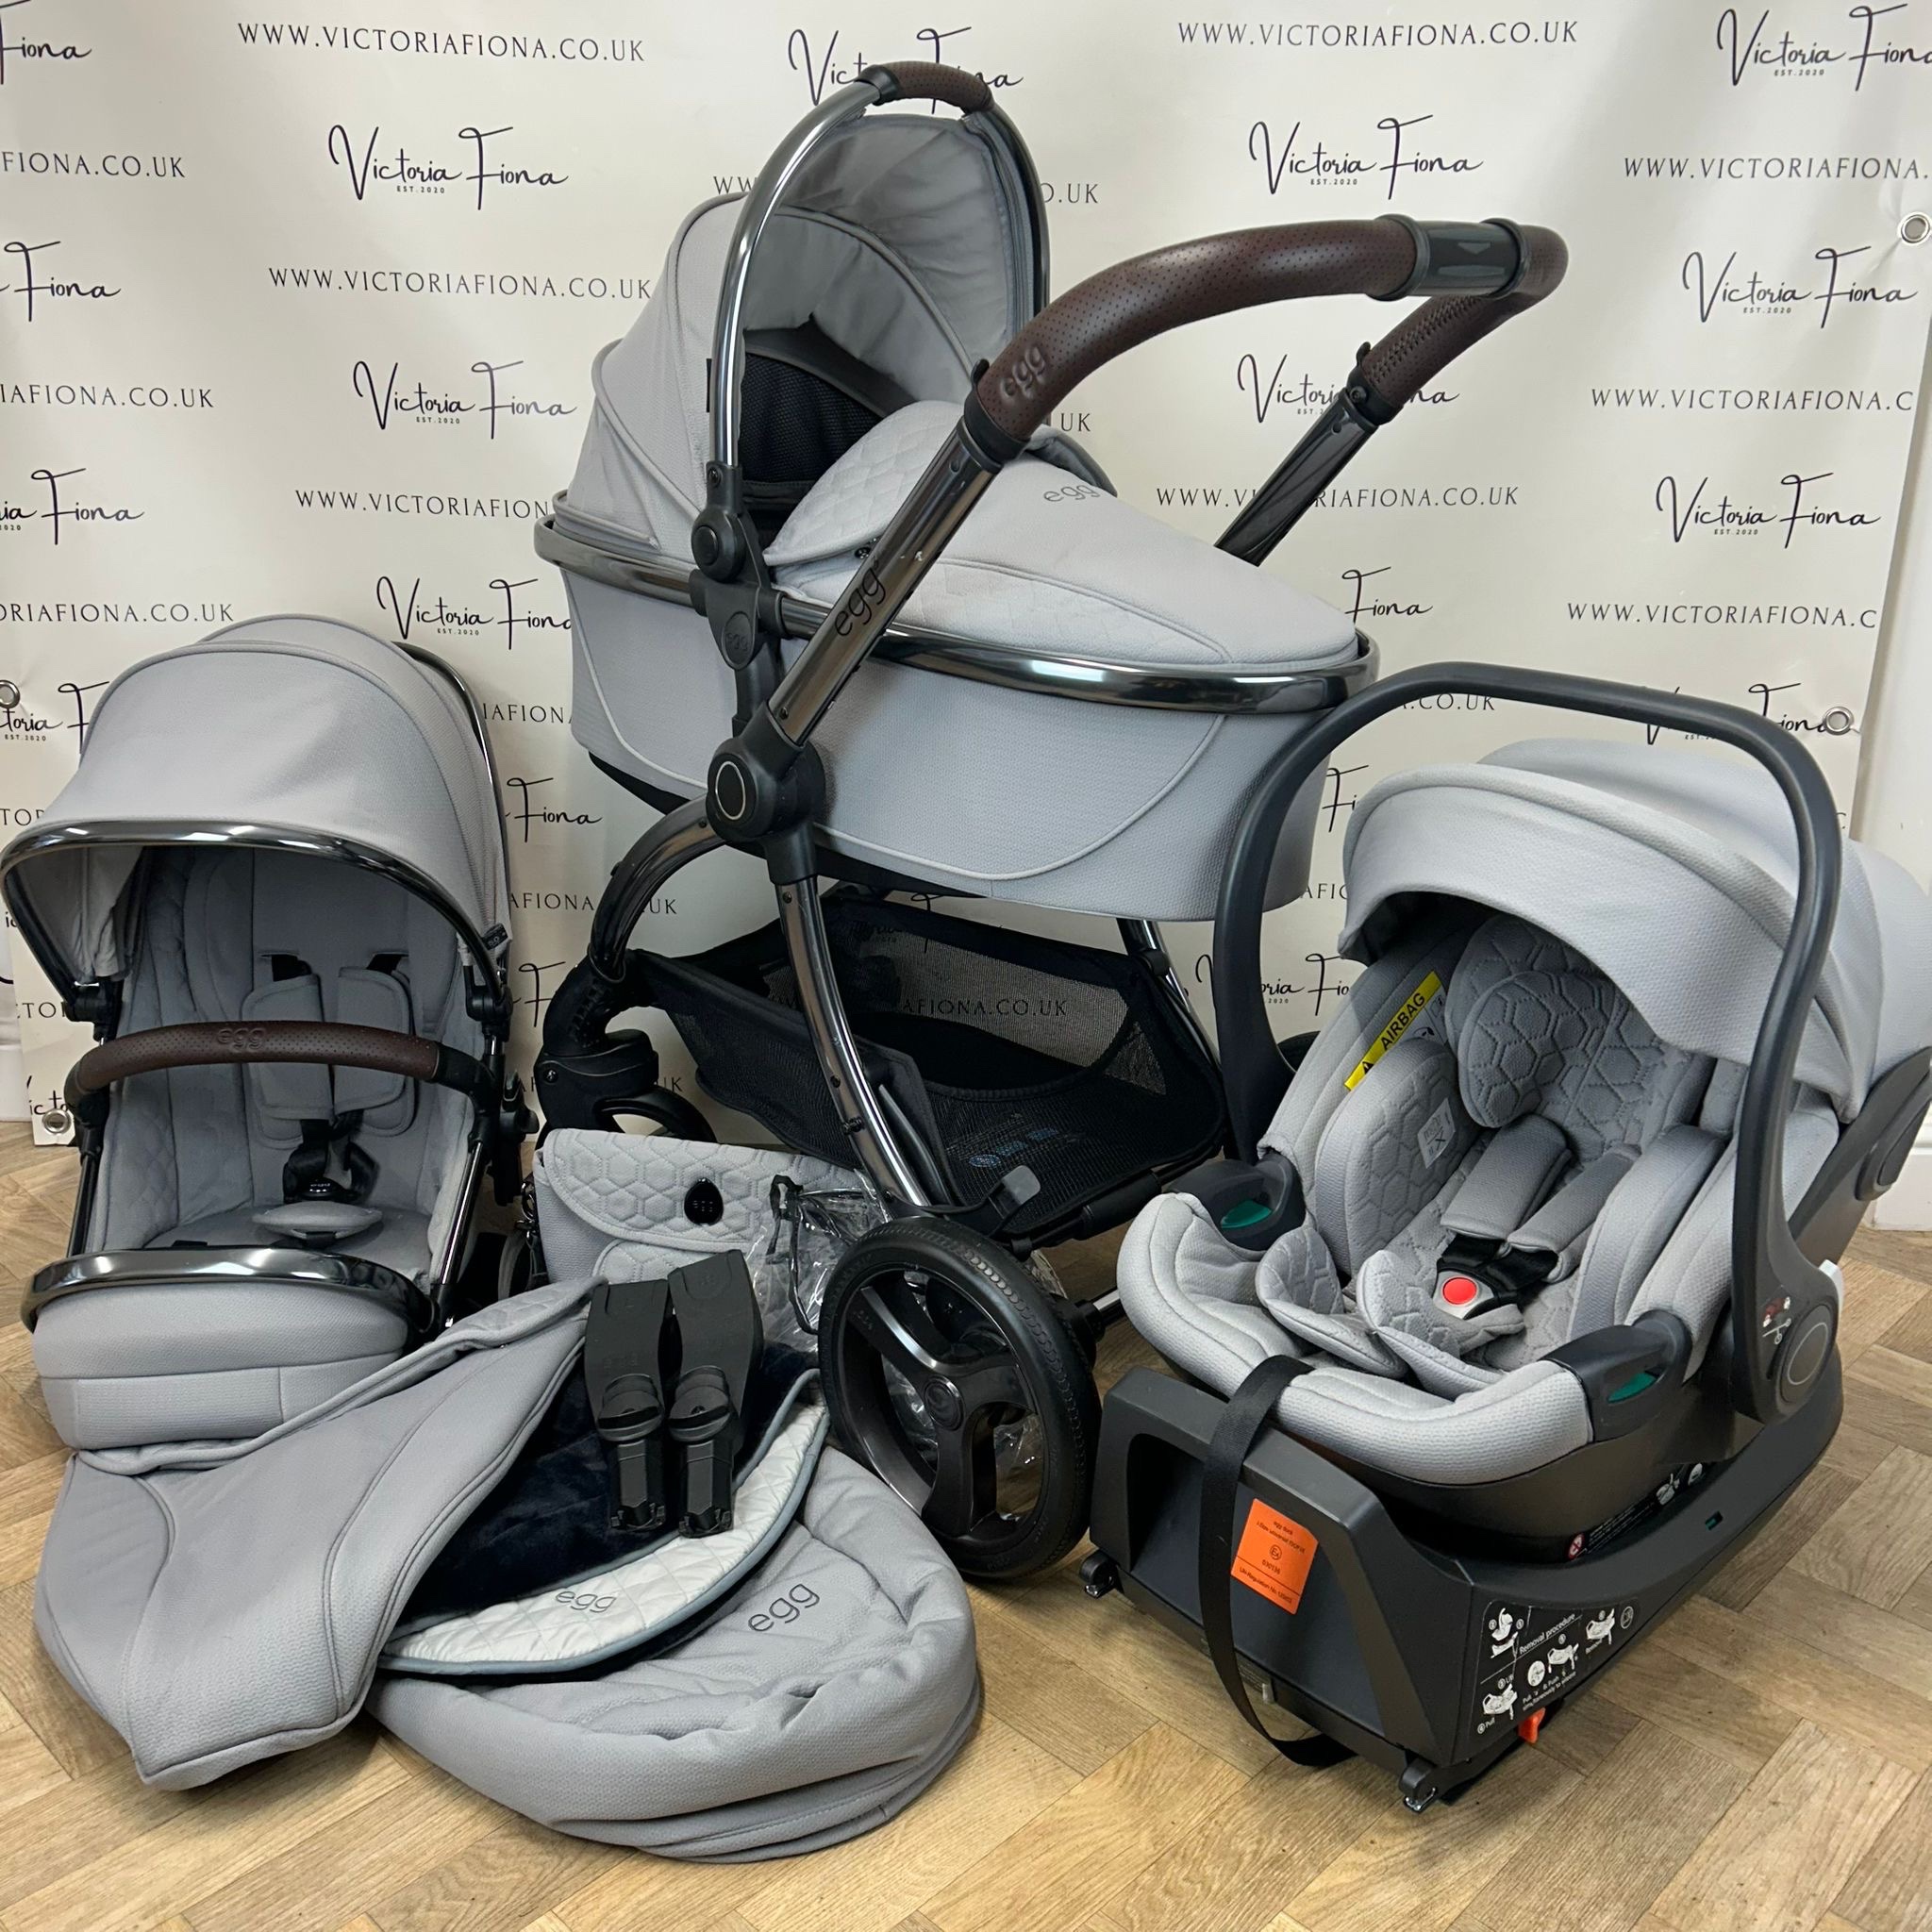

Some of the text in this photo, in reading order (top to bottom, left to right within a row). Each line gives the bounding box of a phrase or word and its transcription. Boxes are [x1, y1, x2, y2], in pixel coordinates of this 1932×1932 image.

[238, 23, 644, 62] WWW.VICTORIAFIONA.CO.UK
[1178, 21, 1578, 46] WWW.VICTORIAFIONA.CO.UK
[1717, 8, 1846, 86] Victoria
[328, 125, 569, 210] Victoria Fiona
[1249, 114, 1484, 200] Victoria Fiona
[1624, 157, 1930, 179] WWW.VICTORIAFIONA.
[396, 185, 445, 194] EST.2020
[4, 241, 121, 322] Fiona
[269, 267, 652, 300] WWW.VICTORIAFIONA.CO.UK
[1682, 245, 1919, 328] Victoria Fiona
[353, 360, 577, 440] Victoria Fiona
[1000, 344, 1046, 404] egg
[1591, 389, 1914, 411] WWW.VICTORIAFIONA.C
[416, 416, 460, 425] EST.2020
[31, 468, 145, 545] Fiona
[1043, 484, 1101, 503] egg
[1656, 472, 1882, 549] Victoria Fiona
[376, 575, 494, 640] Victoria
[834, 567, 887, 636] egg
[1341, 566, 1433, 624] Fiona
[1568, 603, 1877, 629] WWW.VICTORIAFIONA.C
[437, 627, 480, 636] EST.2020
[5, 733, 47, 742] EST.2020
[507, 777, 604, 842] Fiona
[1306, 953, 1350, 1016] Fio
[218, 1027, 265, 1053] egg
[1380, 992, 1426, 1051] AIRBAG
[555, 1591, 617, 1613] egg
[748, 1583, 821, 1632] egg
